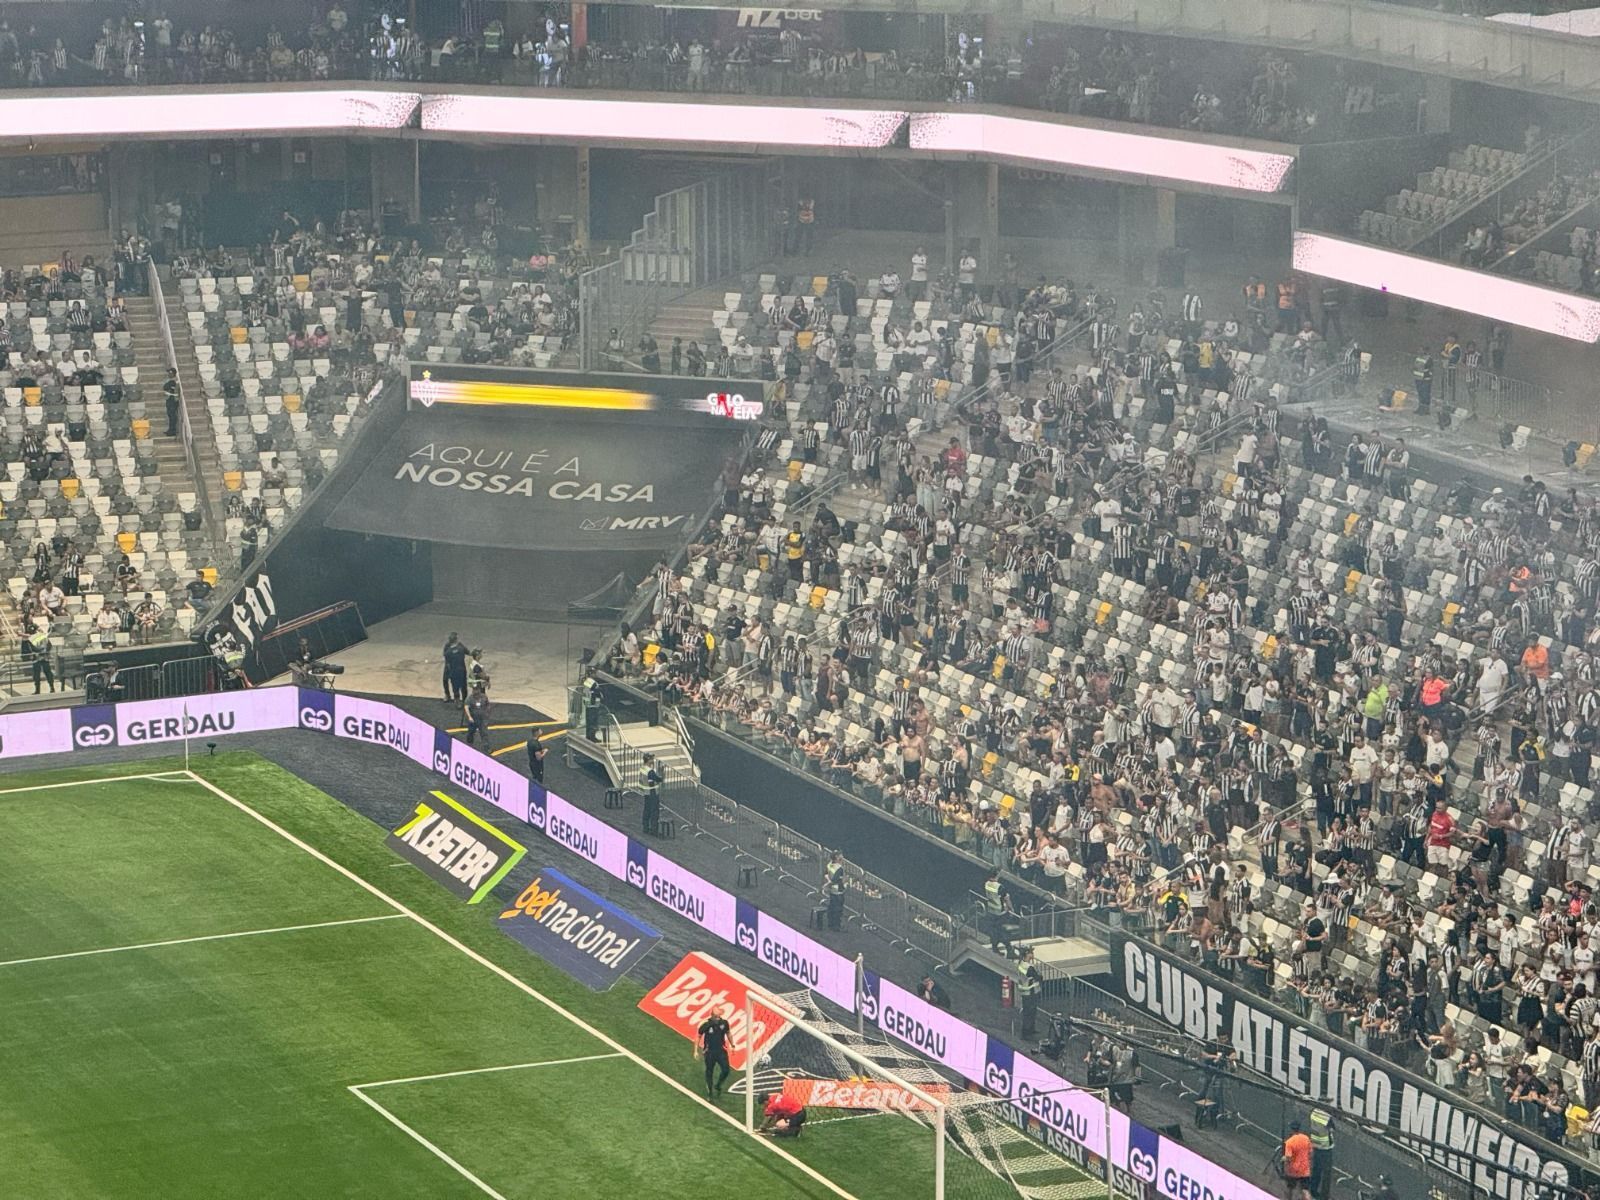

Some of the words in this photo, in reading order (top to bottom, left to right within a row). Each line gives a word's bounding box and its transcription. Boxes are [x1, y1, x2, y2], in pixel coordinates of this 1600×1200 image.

[408, 443, 513, 470] AQUI
[521, 449, 549, 473] É
[554, 456, 579, 476] A
[395, 462, 533, 497] NOSSA
[549, 480, 654, 503] CASA
[609, 514, 685, 531] MRV
[127, 711, 235, 741] GERDAU
[343, 715, 410, 752] GERDAU
[454, 762, 501, 802] GERDAU
[550, 816, 598, 859] GERDAU
[651, 874, 705, 922] GERDAU
[513, 877, 640, 969] betnacional
[763, 937, 819, 986] GERDAU
[885, 1006, 946, 1058] GERDAU
[1124, 941, 1223, 1040] CLUBE
[1232, 1001, 1392, 1126] ATLÉTICO
[1400, 1083, 1569, 1200] MINEIRO
[808, 1080, 920, 1110] Betano
[1018, 1081, 1088, 1142] GERDAU
